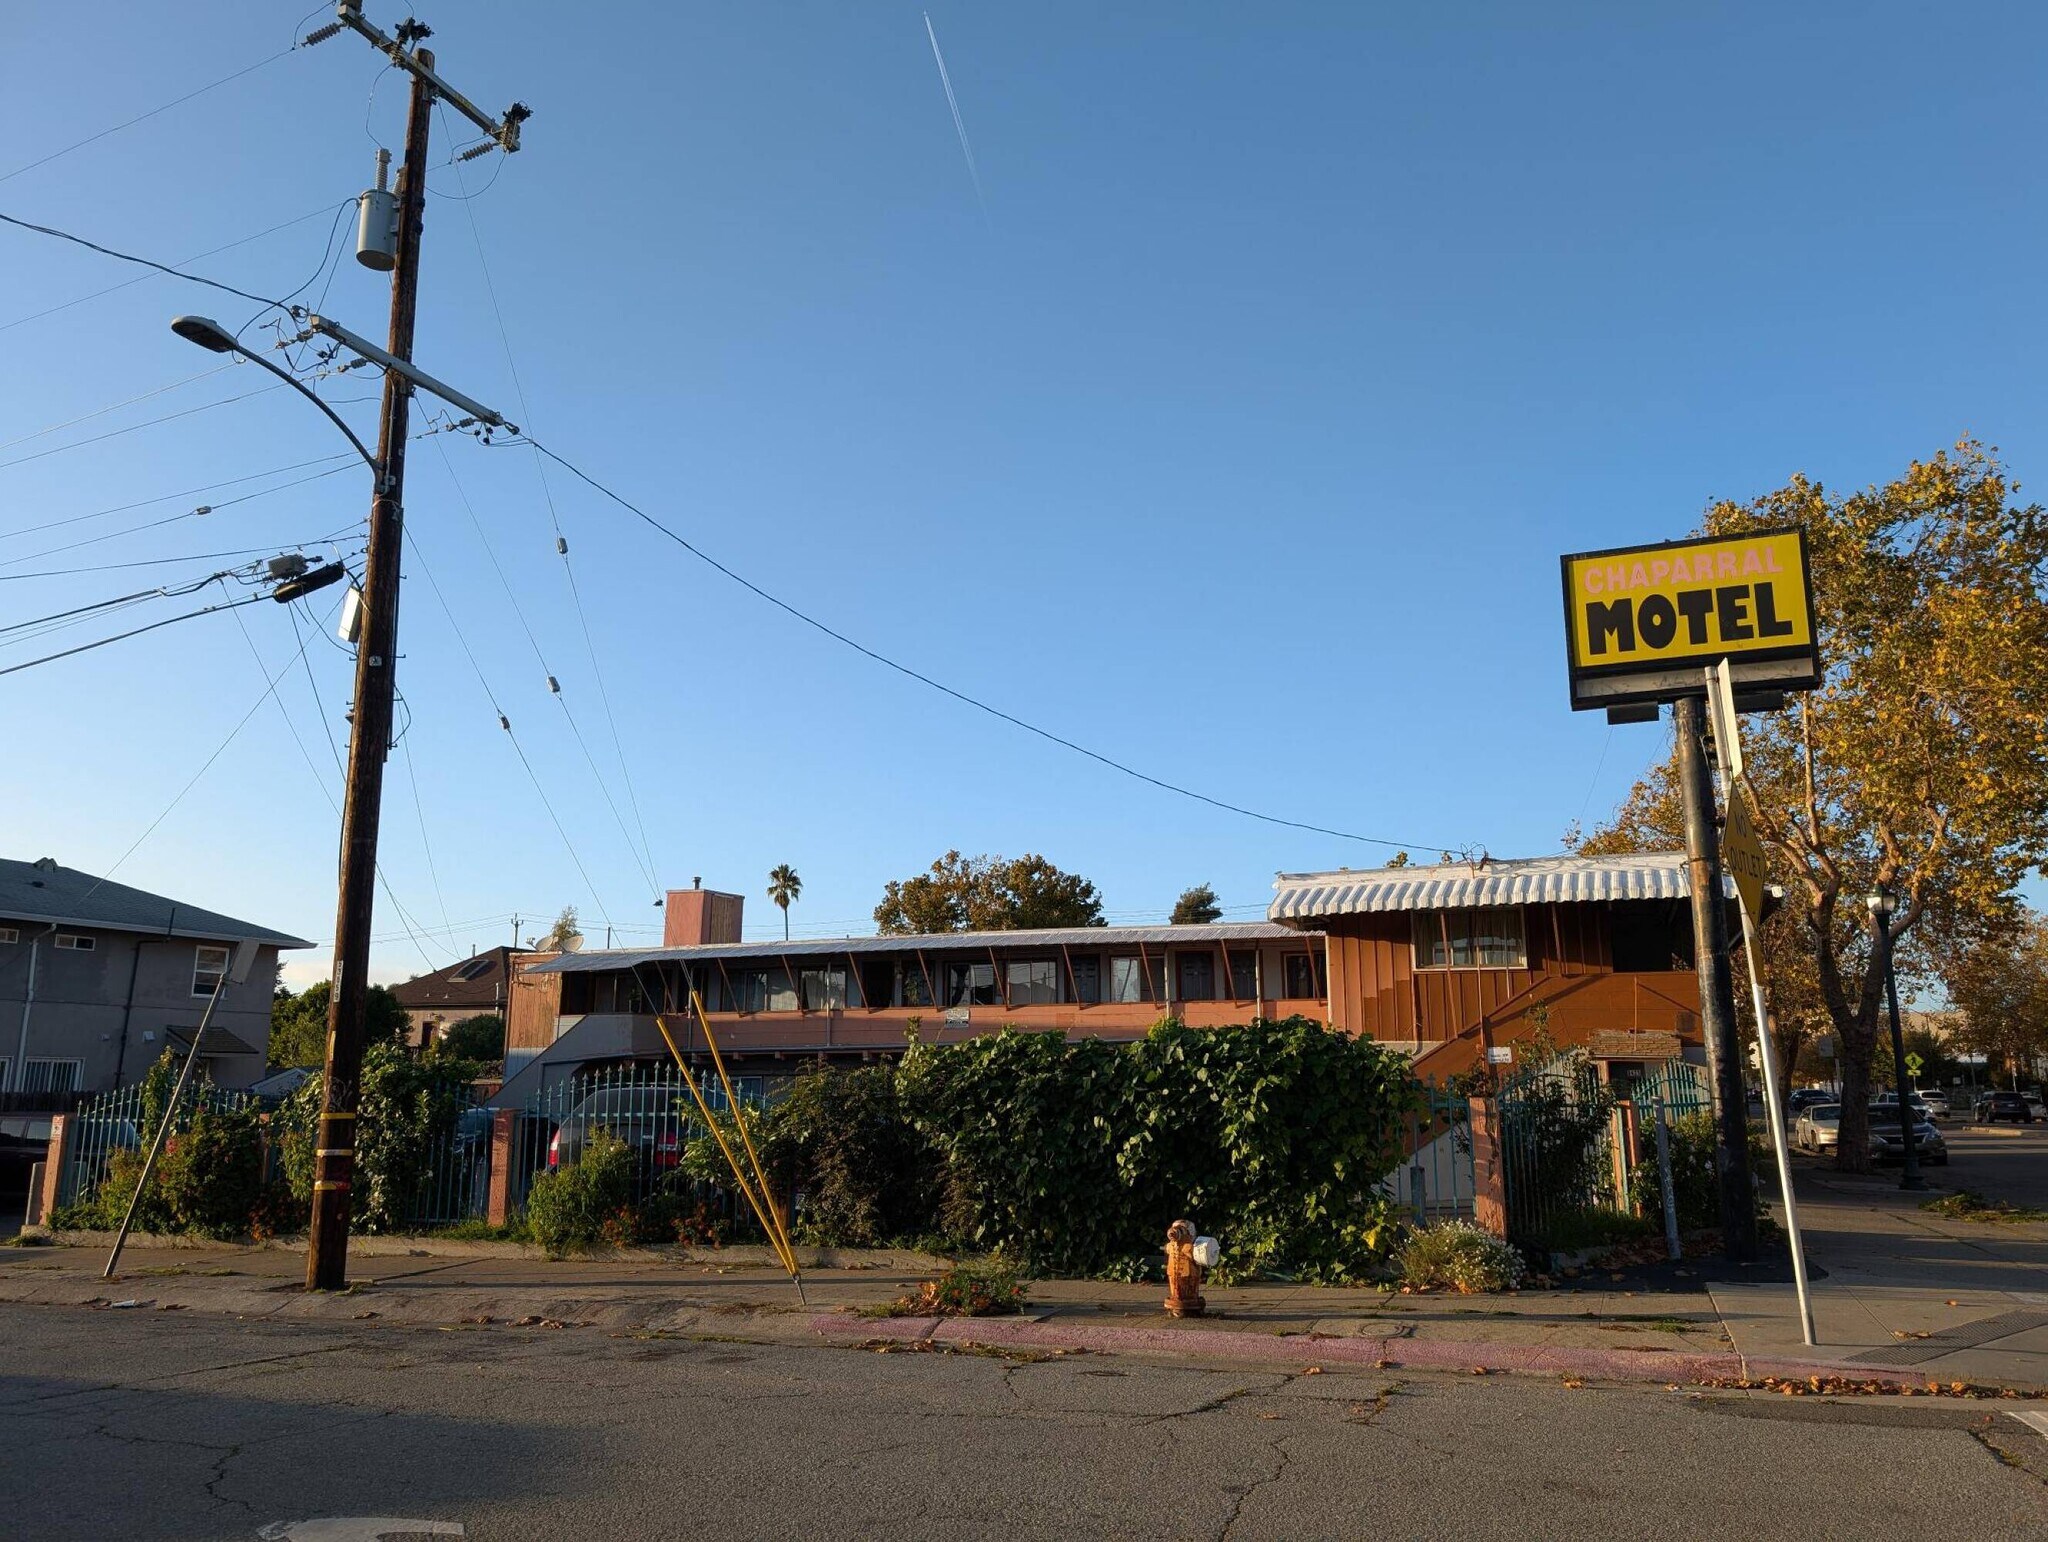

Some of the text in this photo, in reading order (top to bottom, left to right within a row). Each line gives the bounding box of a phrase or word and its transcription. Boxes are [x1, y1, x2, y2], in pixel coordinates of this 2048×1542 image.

[1584, 546, 1784, 594] CHAPARRAL
[1586, 582, 1793, 656] MOTEL
[1734, 811, 1747, 838] NO
[1730, 846, 1763, 880] OUTLET
